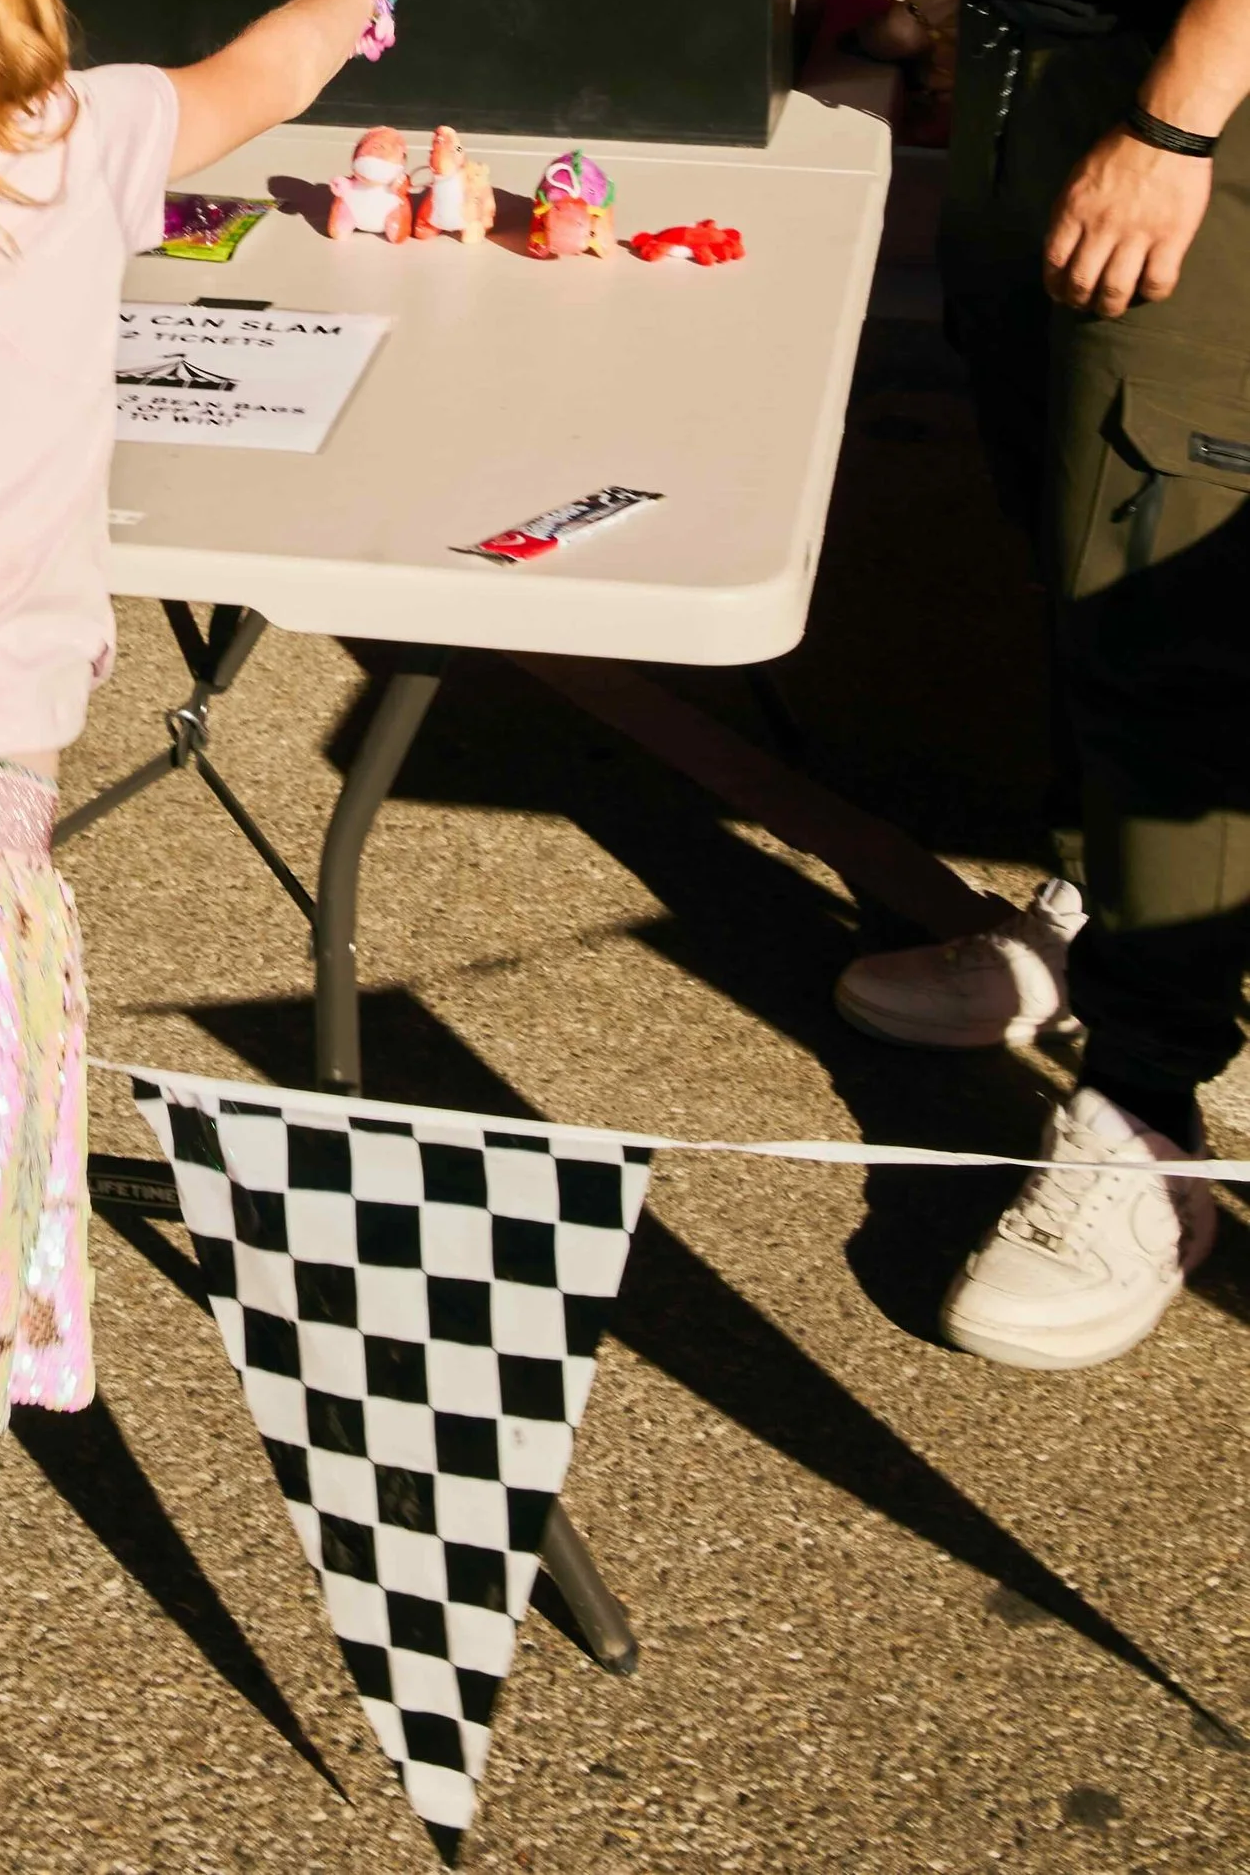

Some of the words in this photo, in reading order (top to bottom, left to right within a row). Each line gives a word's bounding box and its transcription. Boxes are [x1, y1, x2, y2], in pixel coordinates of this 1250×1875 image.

[150, 314, 225, 329] CAN
[240, 319, 343, 335] SLAM
[155, 332, 277, 348] TICKETS
[151, 396, 222, 408] BEAN
[234, 402, 306, 415] BAGS
